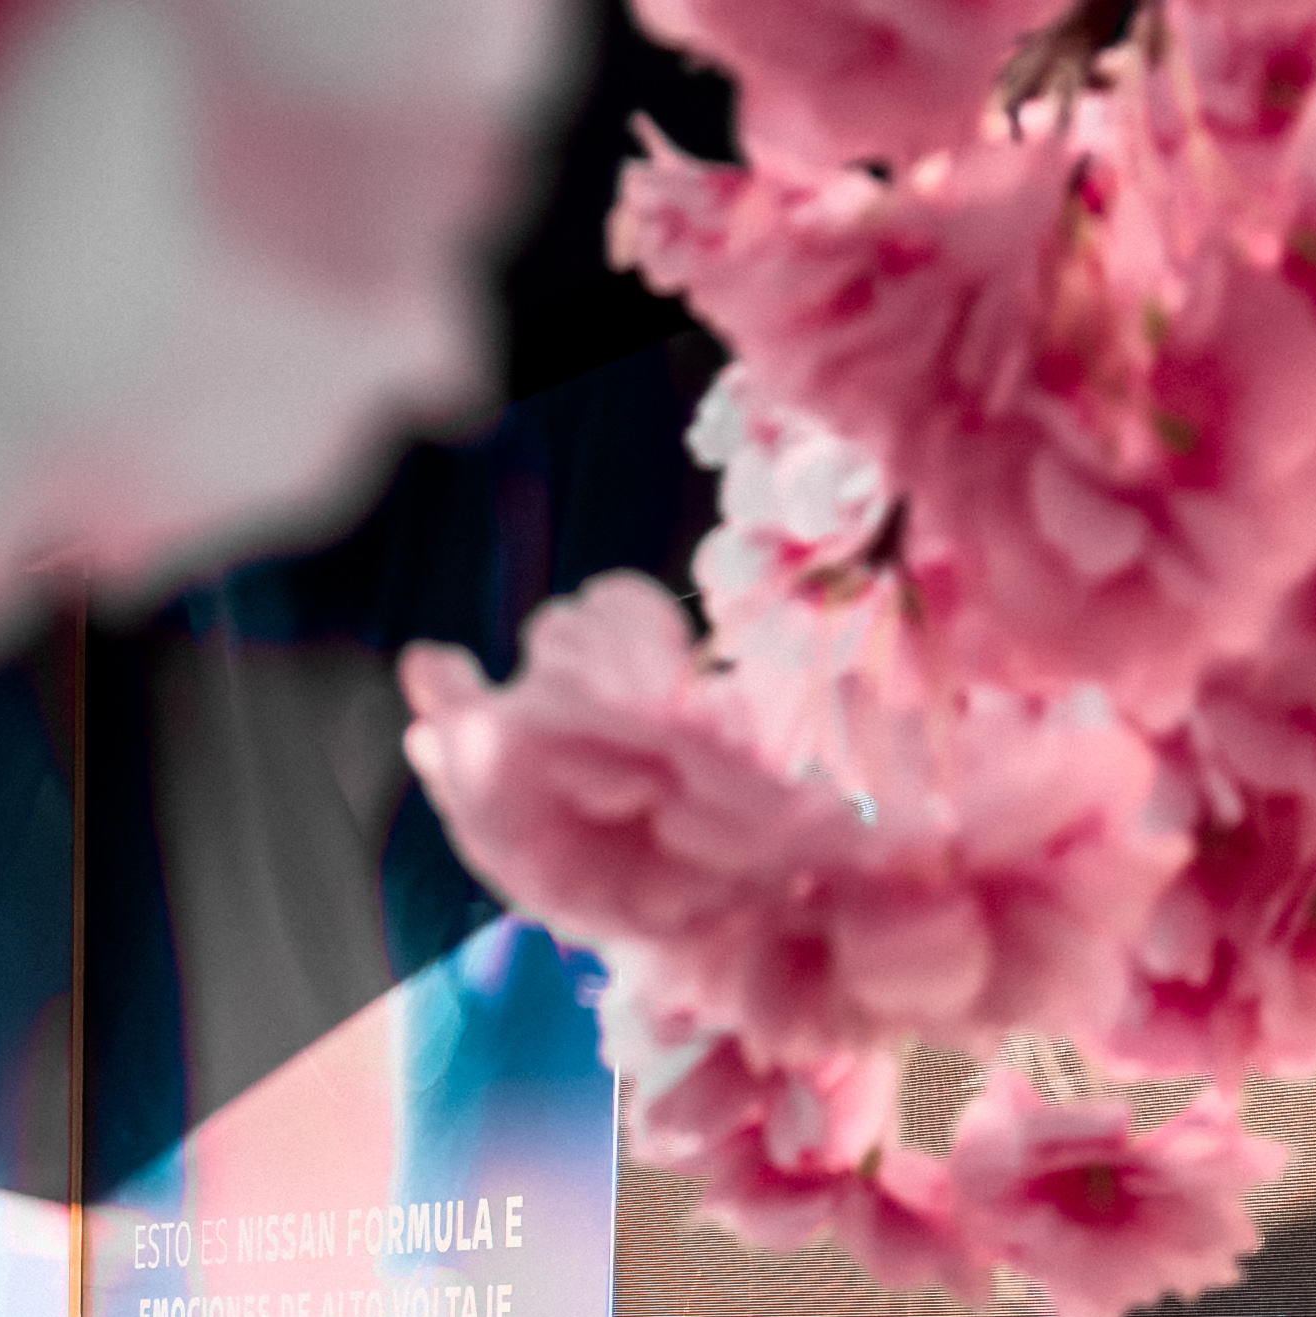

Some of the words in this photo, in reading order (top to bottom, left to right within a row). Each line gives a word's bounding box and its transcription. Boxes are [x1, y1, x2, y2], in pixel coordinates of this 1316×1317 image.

[134, 1220, 192, 1270] ESTO
[201, 1218, 229, 1266] ES
[238, 1210, 336, 1263] NISSAN
[346, 1198, 493, 1257] FORMULA
[505, 1195, 524, 1249] E
